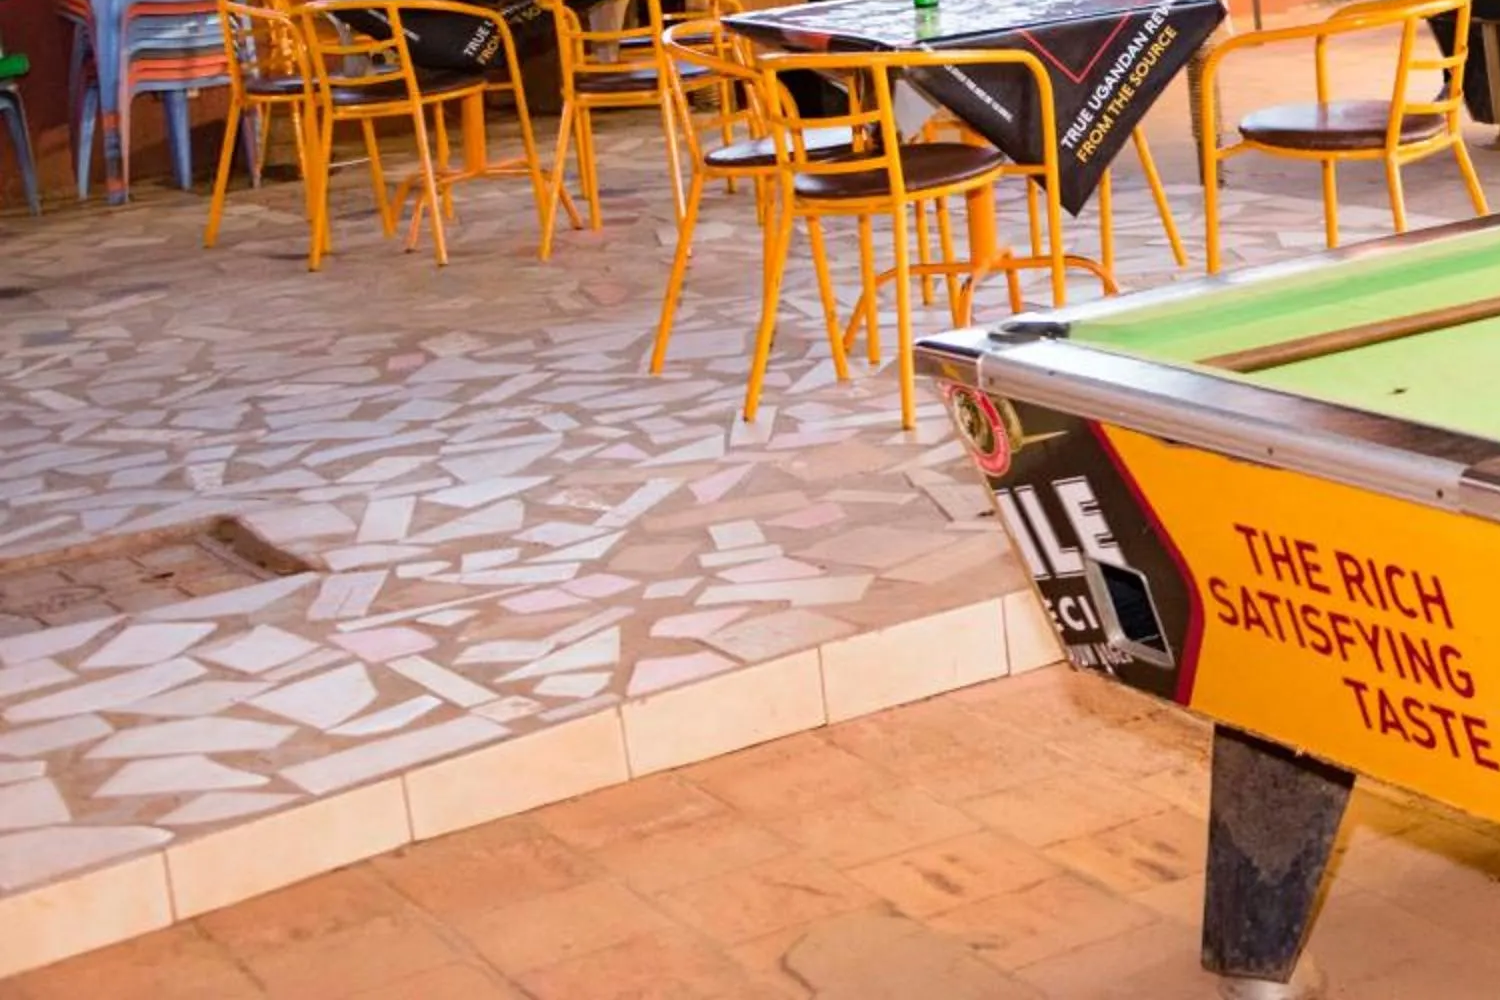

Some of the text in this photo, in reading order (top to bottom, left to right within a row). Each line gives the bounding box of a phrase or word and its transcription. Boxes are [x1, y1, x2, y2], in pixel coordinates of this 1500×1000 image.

[463, 24, 487, 57] TRUE
[1060, 112, 1093, 149] TRUE
[1088, 31, 1148, 110] UGANDAN
[1076, 25, 1178, 165] FROM THE SOURCE
[994, 475, 1129, 579] ILE
[1233, 523, 1457, 631] THE RICH
[1208, 576, 1477, 700] SATISFYING
